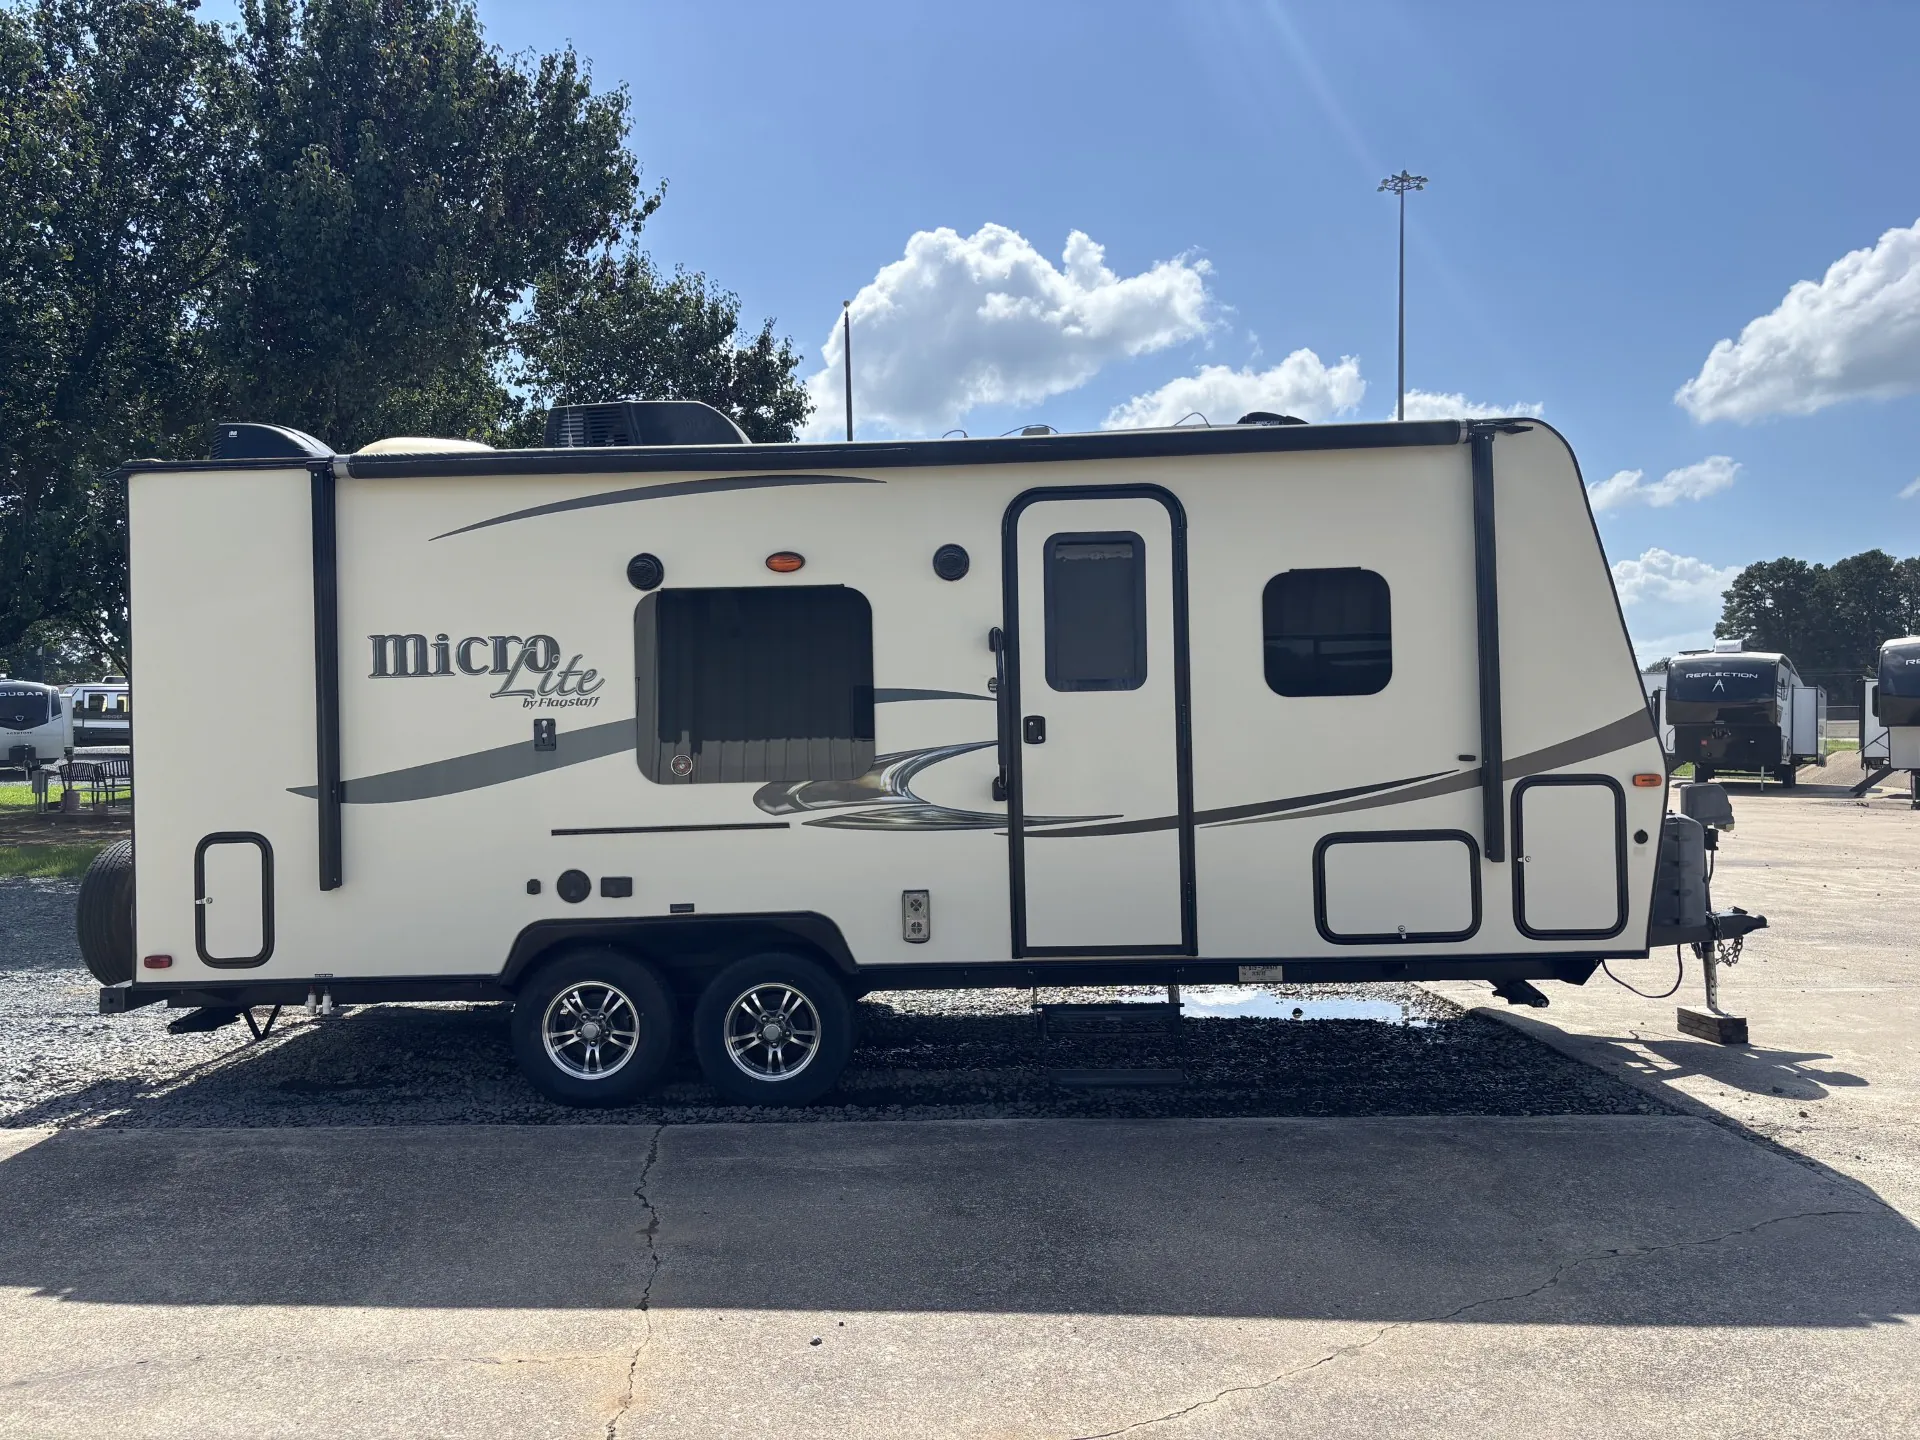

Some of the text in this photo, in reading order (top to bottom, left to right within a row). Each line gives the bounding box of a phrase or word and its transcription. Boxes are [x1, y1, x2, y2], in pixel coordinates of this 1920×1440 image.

[367, 633, 561, 679] micro
[490, 646, 606, 699] Lite
[1685, 671, 1759, 679] REFLECTION
[522, 696, 601, 710] by Flagstaff
